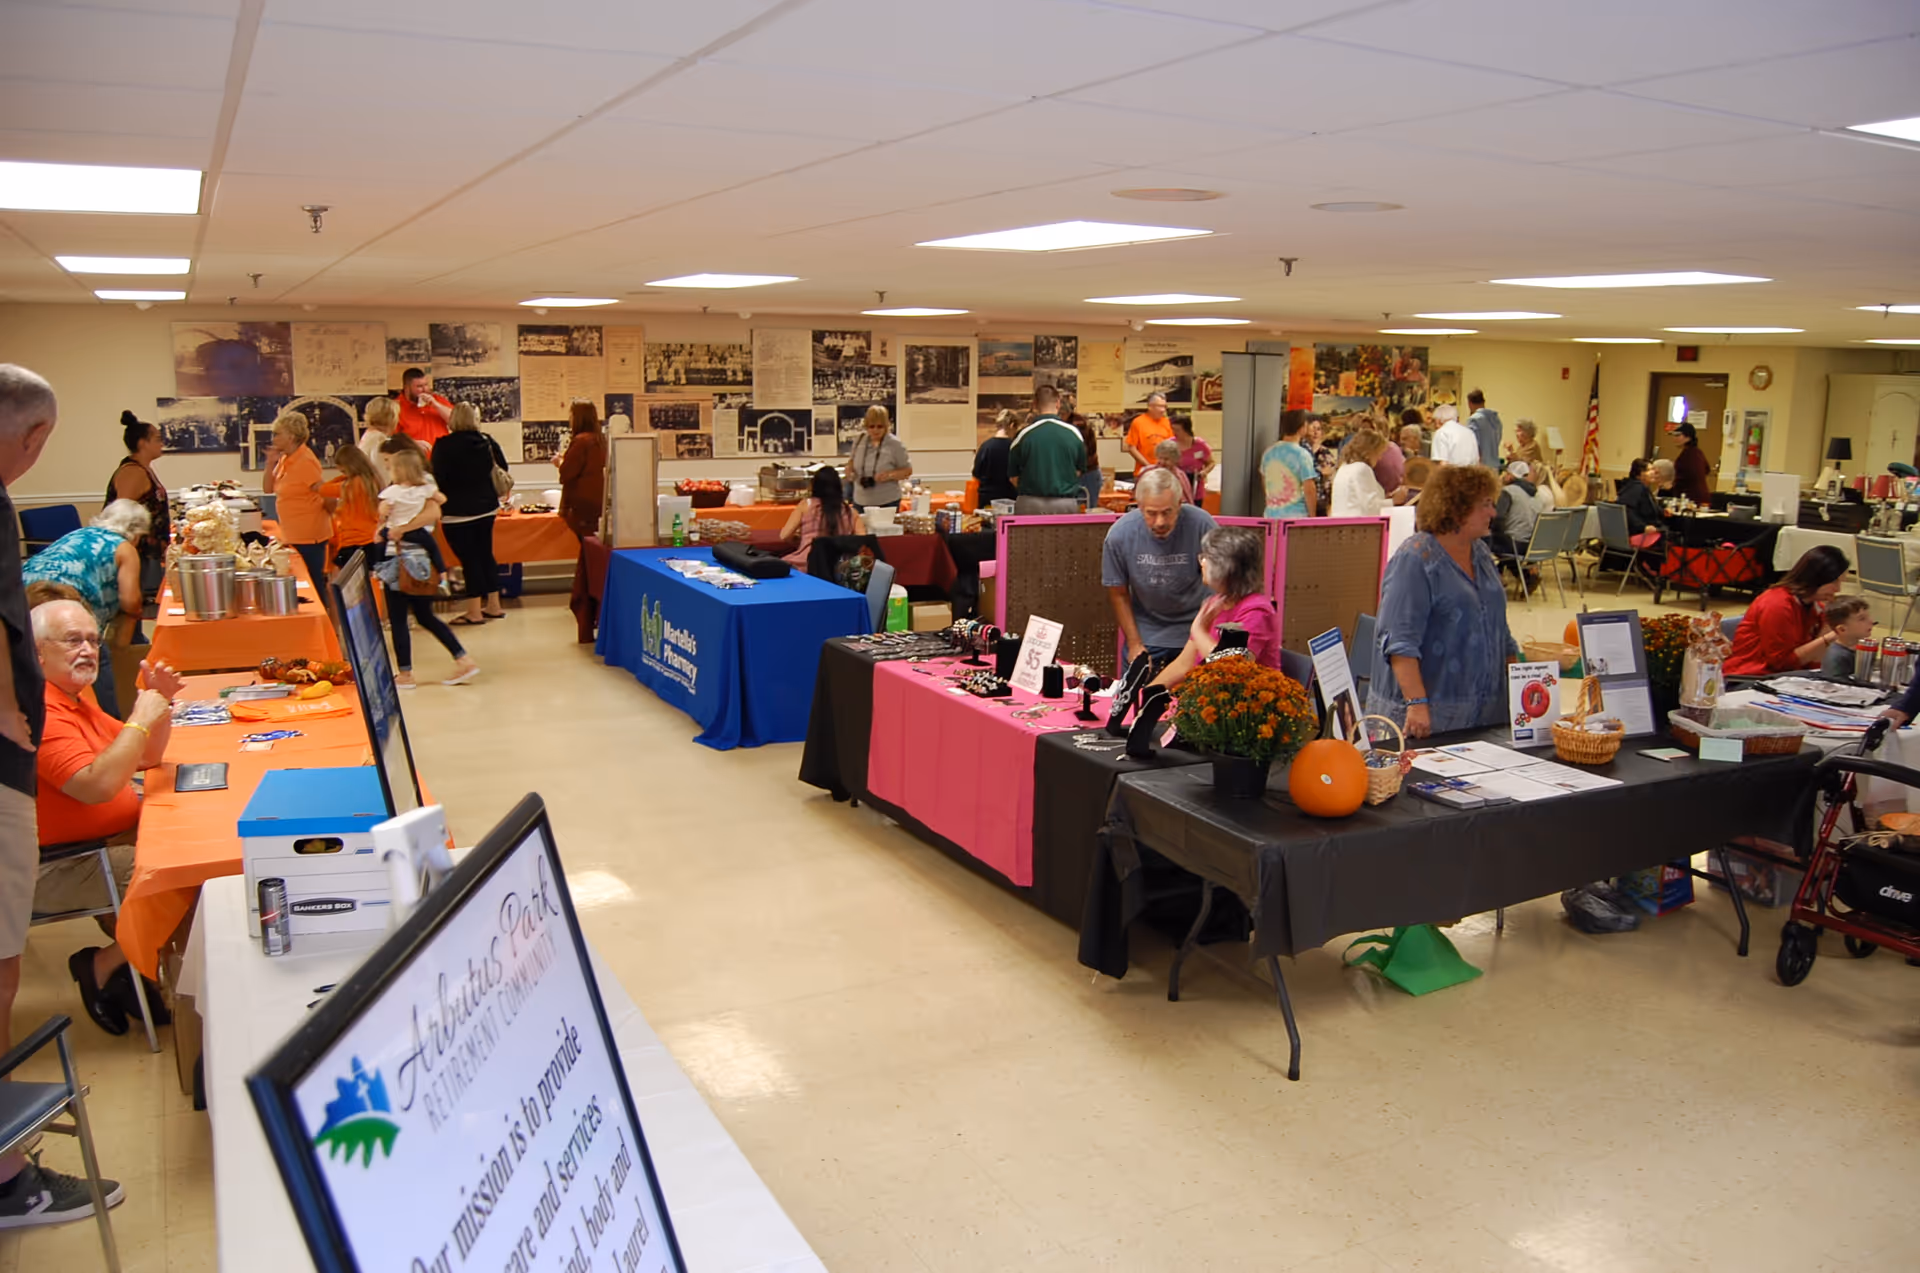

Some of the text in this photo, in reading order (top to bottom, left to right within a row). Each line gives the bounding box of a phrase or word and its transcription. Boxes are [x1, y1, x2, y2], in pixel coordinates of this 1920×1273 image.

[664, 620, 697, 656] Martella's
[664, 644, 698, 687] Pharmacy
[1025, 647, 1043, 670] $5
[293, 902, 353, 912] BANKERS BOX
[1879, 885, 1912, 903] drive
[397, 854, 559, 1111] Arbutus Park
[422, 926, 558, 1134] RETIREMENT COMMUNITY
[452, 1144, 514, 1262] mission
[504, 1113, 527, 1162] is
[520, 1096, 541, 1137] to
[537, 1017, 583, 1122] provide
[533, 1160, 562, 1240] and
[556, 1094, 603, 1193] services
[580, 1174, 616, 1249] body
[610, 1126, 632, 1194] and
